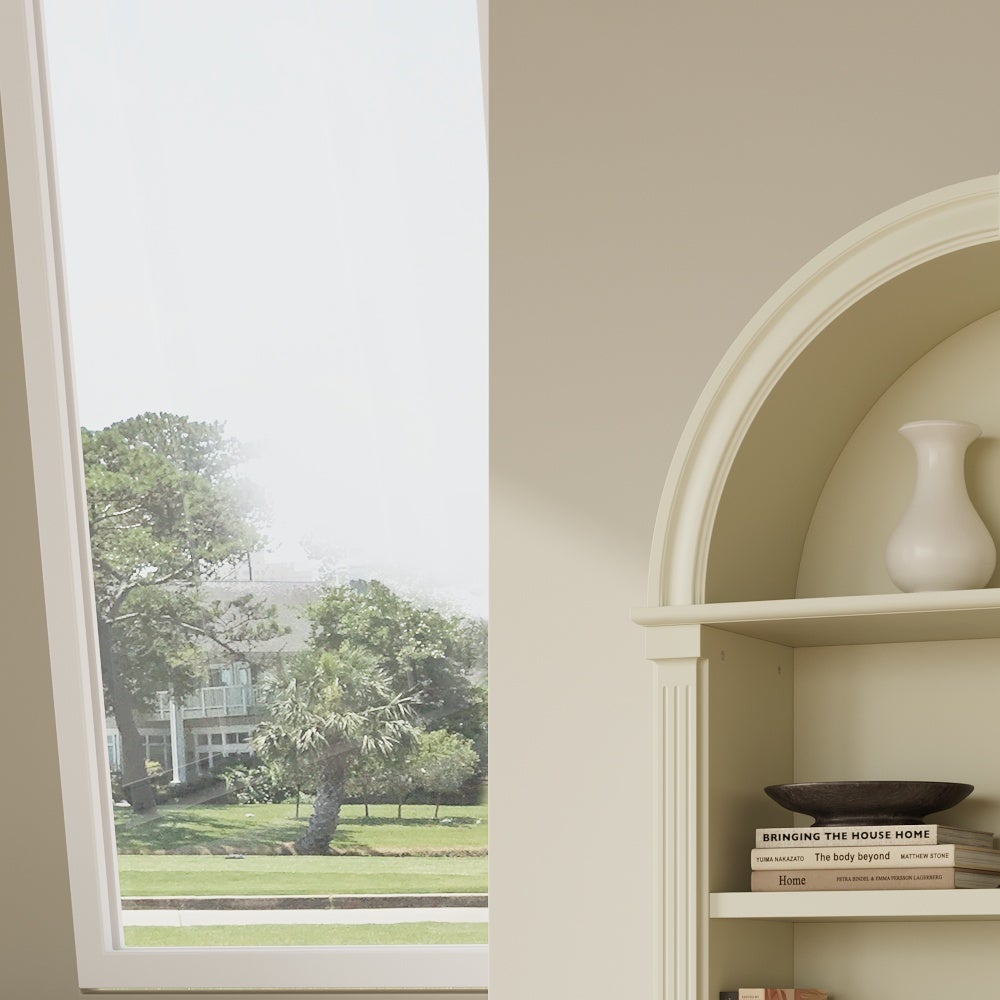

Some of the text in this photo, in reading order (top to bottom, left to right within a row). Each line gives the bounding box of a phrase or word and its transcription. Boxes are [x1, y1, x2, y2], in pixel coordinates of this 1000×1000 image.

[763, 830, 930, 842] BRINGING THE HOUSE HOME
[815, 851, 890, 863] The body beyond
[779, 876, 806, 886] Home
